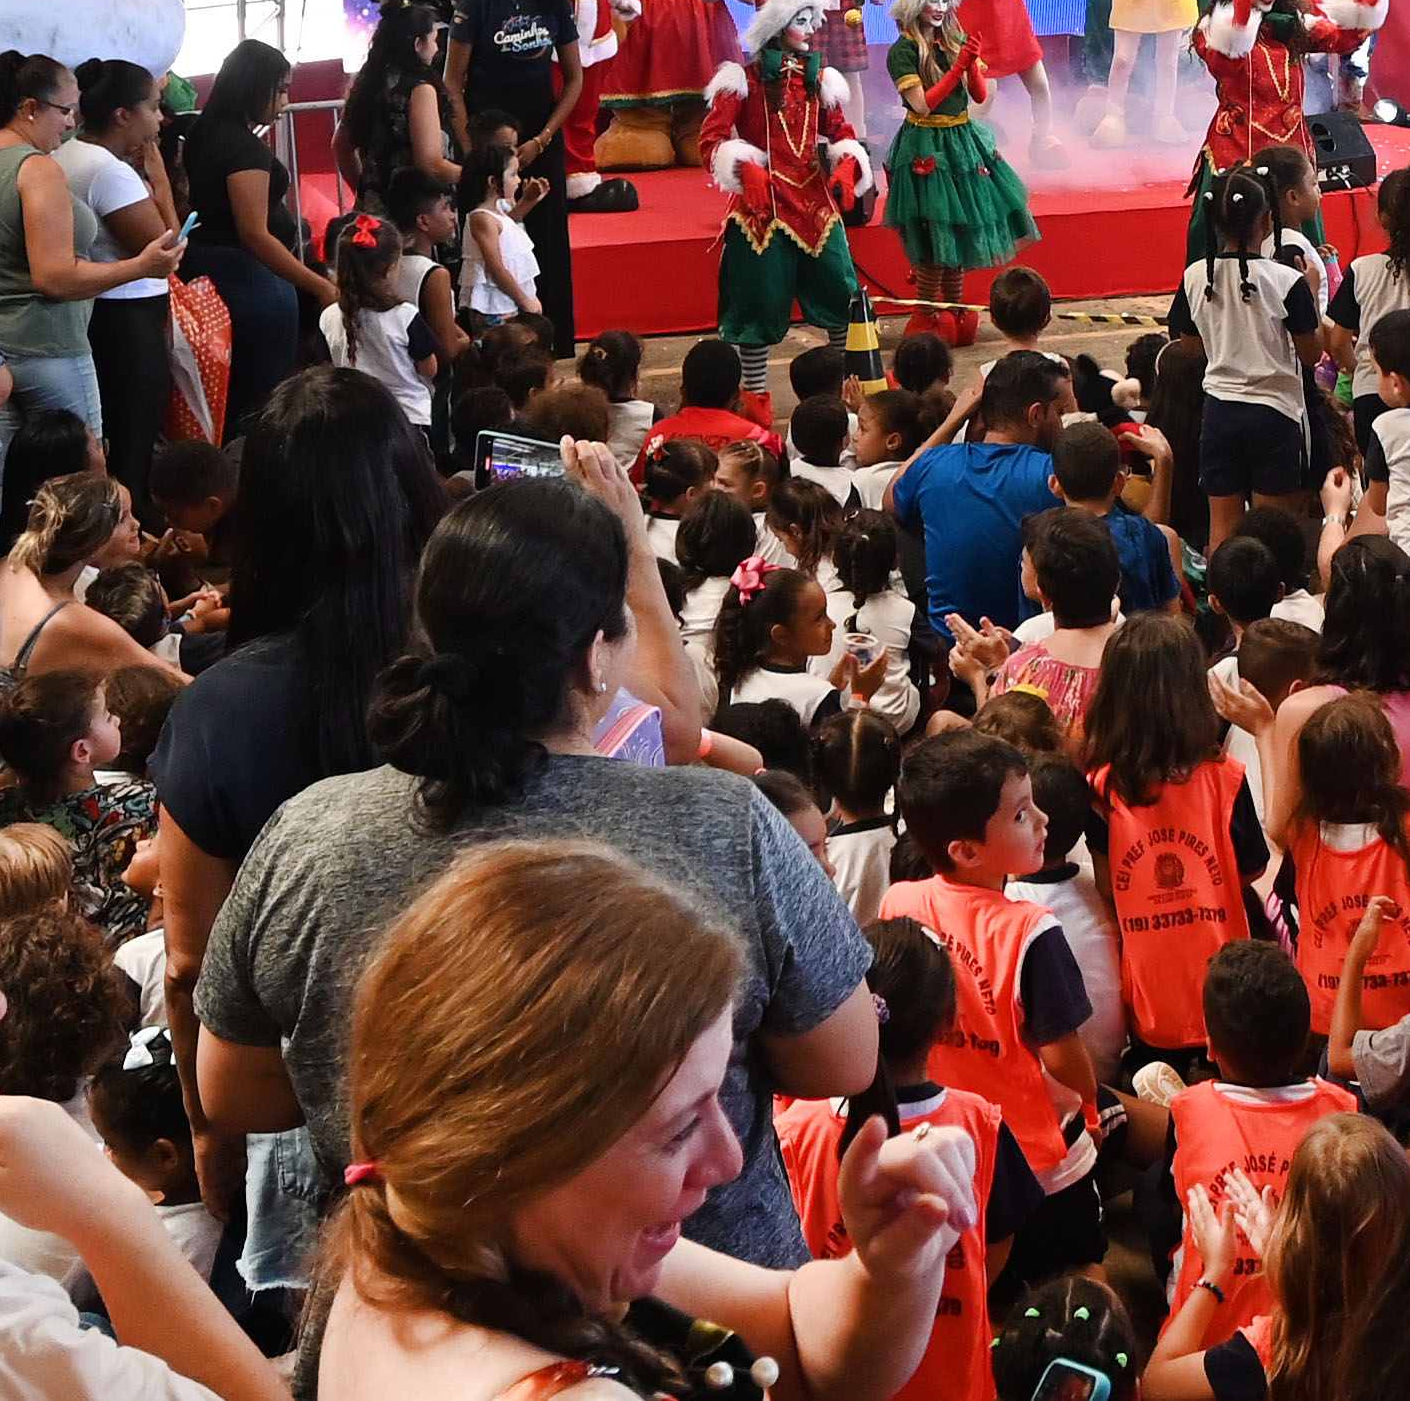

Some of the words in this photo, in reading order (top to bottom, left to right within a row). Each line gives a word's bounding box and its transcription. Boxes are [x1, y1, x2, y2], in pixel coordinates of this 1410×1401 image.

[1122, 840, 1146, 870] PREF
[1178, 830, 1209, 858] PIRES
[1116, 870, 1131, 891] CEI
[1203, 855, 1223, 886] NETO
[1123, 916, 1149, 932] (19)
[955, 941, 983, 977] PIRES
[978, 979, 997, 1016] NETO
[1243, 1150, 1277, 1174] JOSÉ
